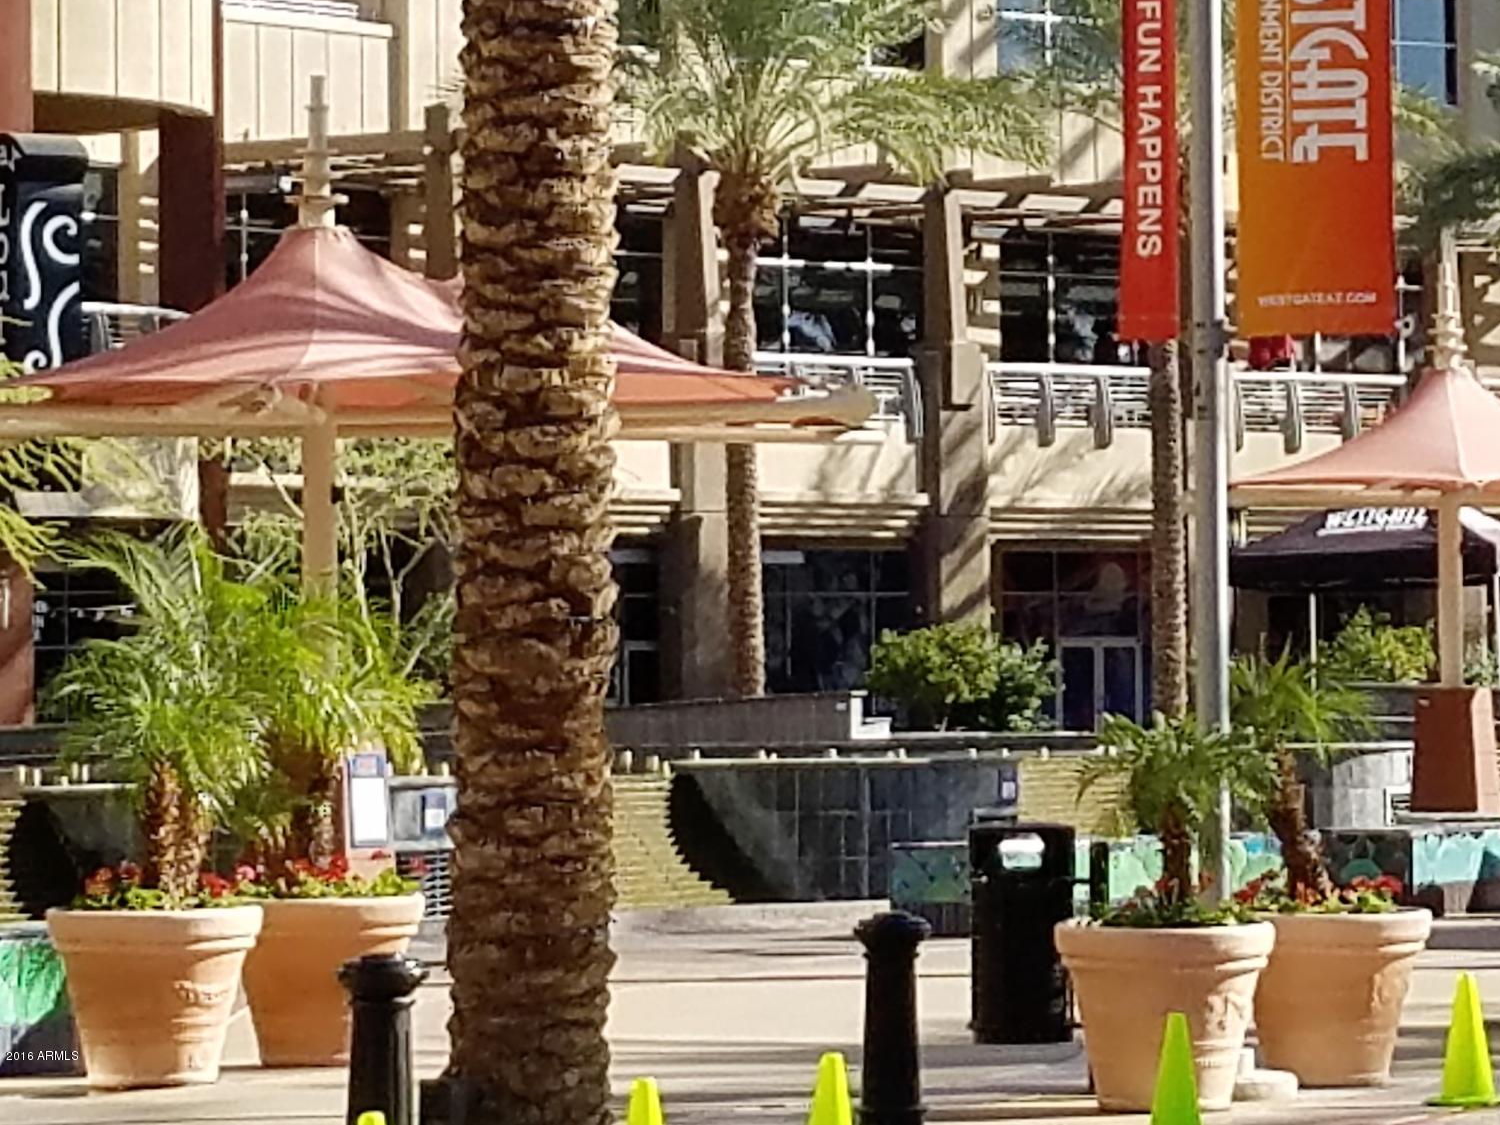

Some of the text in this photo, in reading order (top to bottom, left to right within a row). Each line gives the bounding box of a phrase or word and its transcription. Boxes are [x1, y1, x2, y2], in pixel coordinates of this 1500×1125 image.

[1136, 0, 1162, 73] FUN
[1259, 70, 1286, 162] DISTRICT
[1136, 83, 1162, 259] HAPPENS
